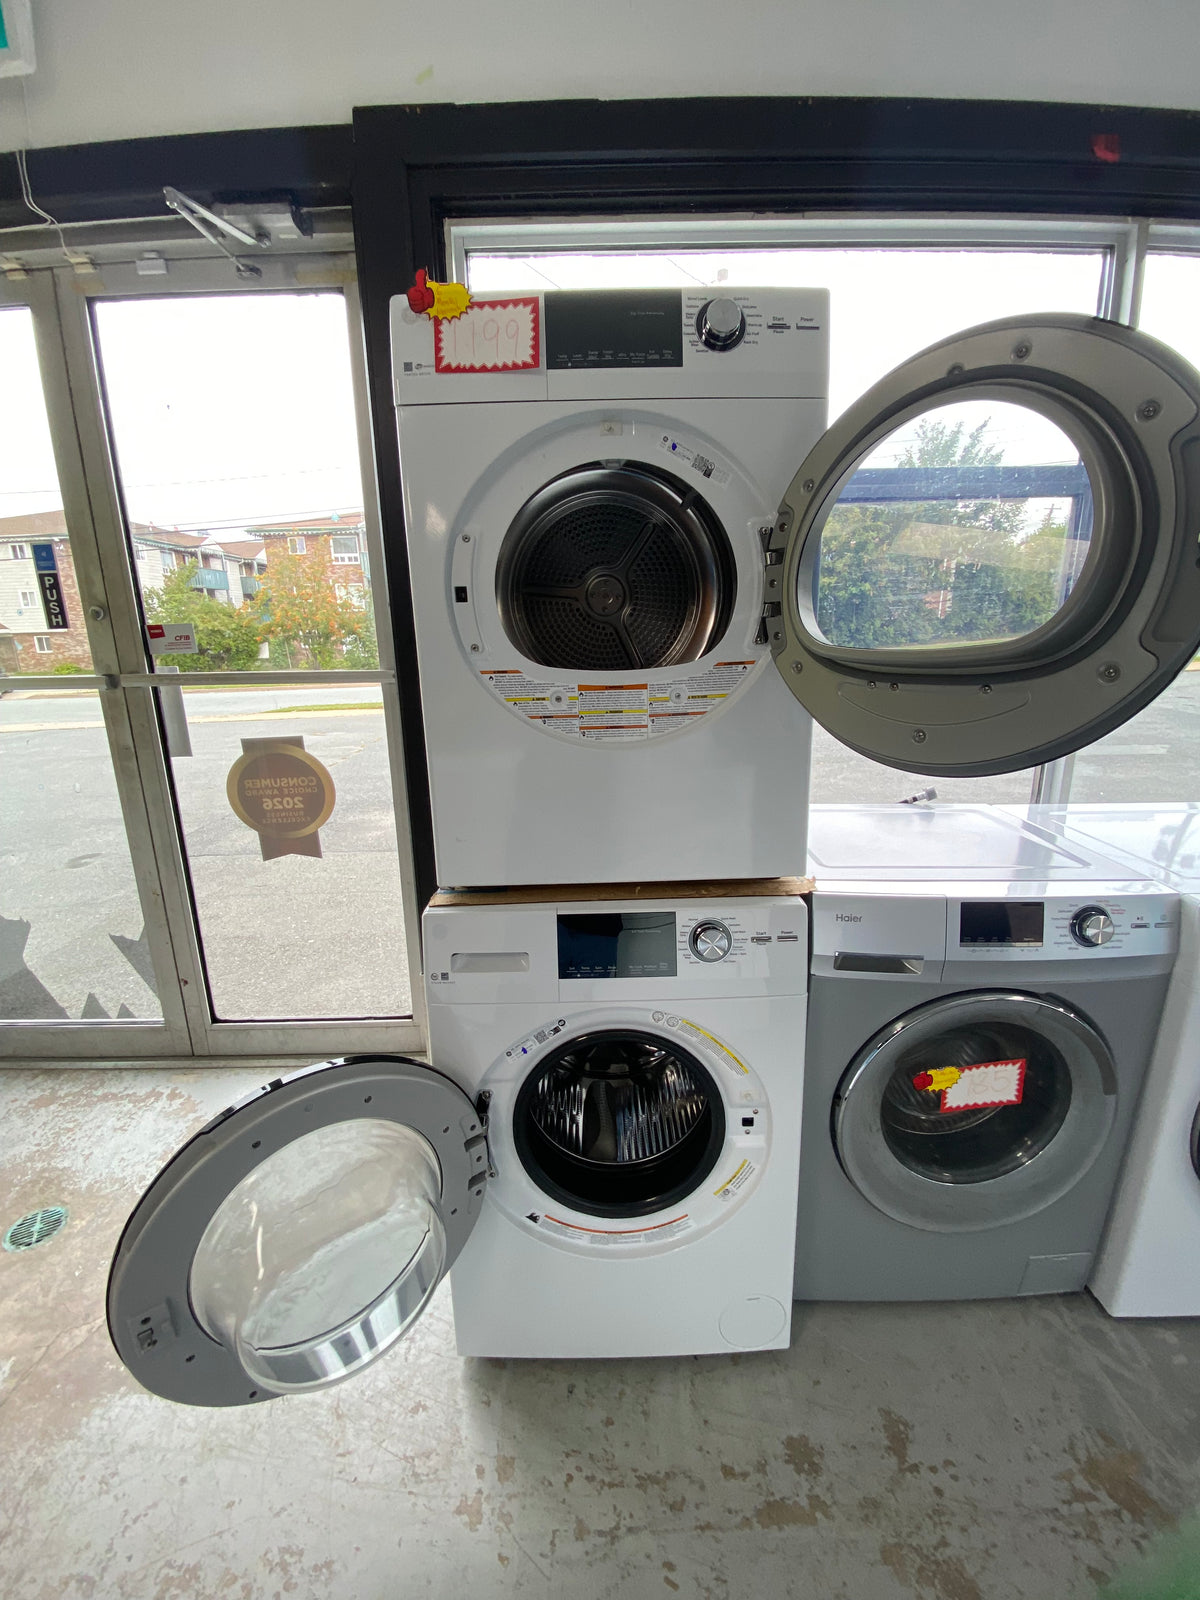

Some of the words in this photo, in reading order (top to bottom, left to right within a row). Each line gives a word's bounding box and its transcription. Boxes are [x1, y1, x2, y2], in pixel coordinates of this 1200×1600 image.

[453, 318, 519, 361] 1199
[44, 576, 63, 626] PUSH
[836, 913, 863, 923] Haier
